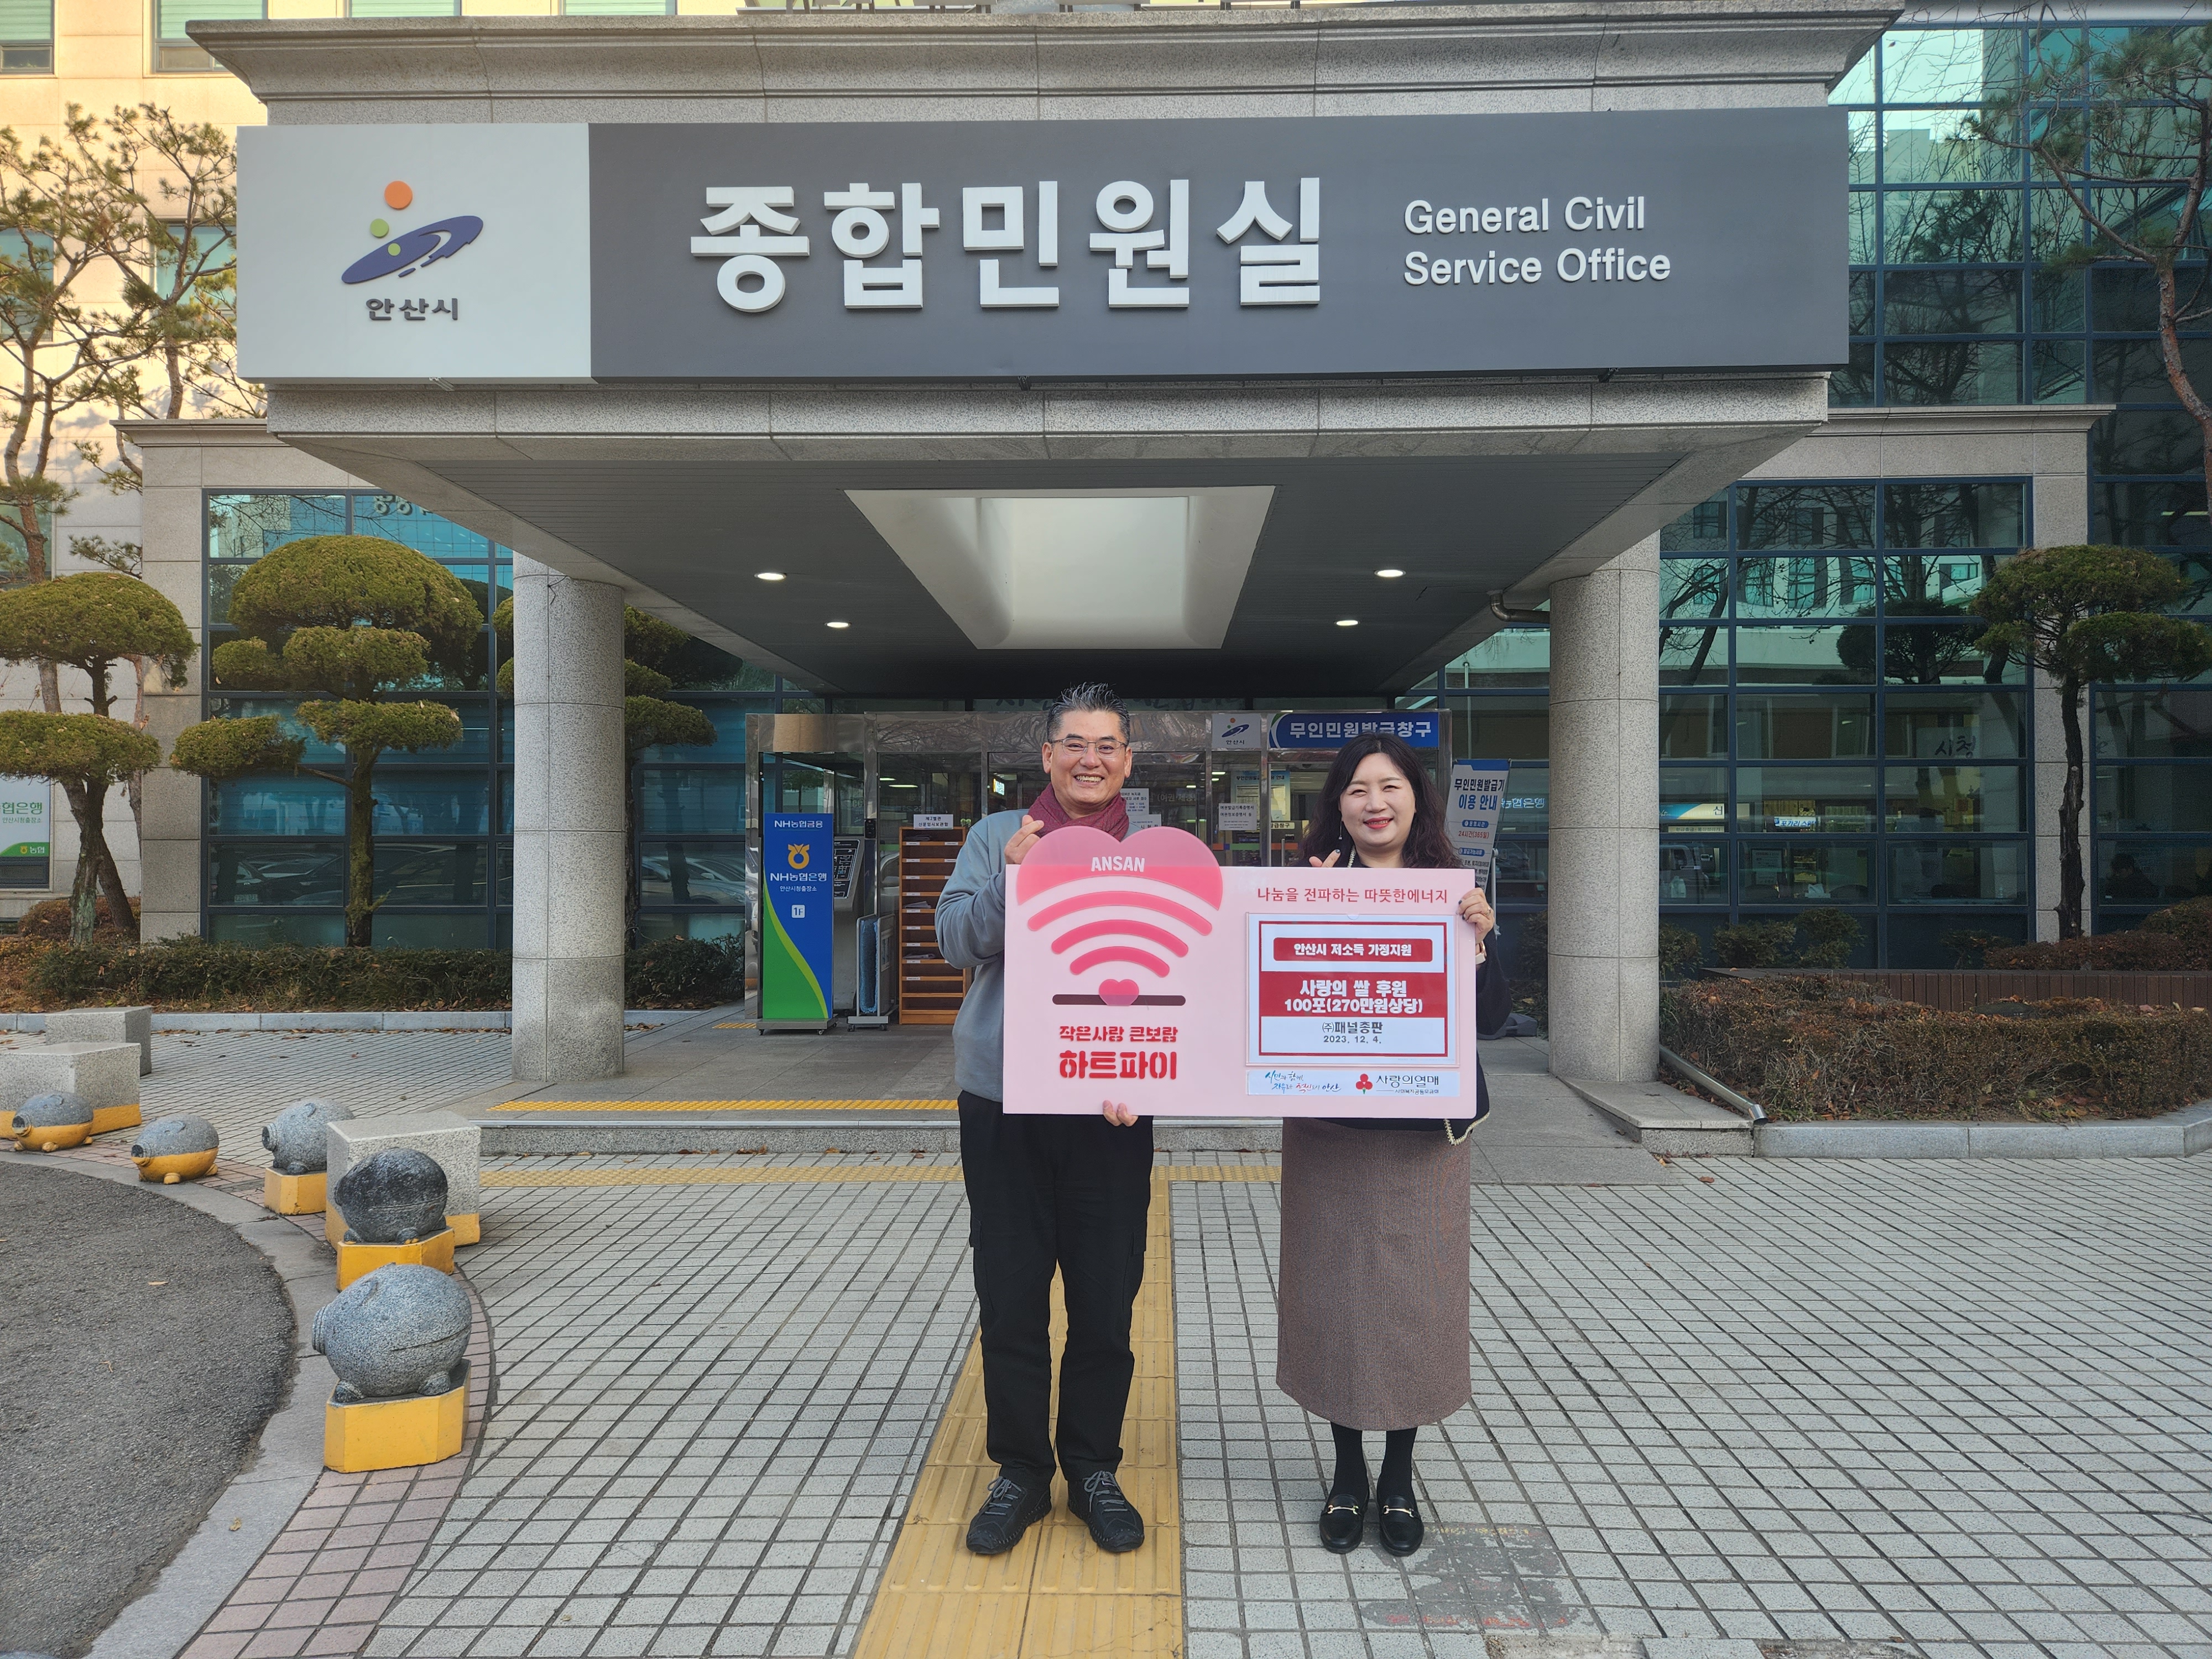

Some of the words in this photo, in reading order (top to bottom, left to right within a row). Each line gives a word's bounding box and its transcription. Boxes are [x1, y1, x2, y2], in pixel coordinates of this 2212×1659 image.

[1404, 198, 1549, 234] General
[1564, 196, 1645, 232] Civil
[690, 176, 1321, 314] 종합민원실
[1404, 250, 1542, 286] Service
[1557, 247, 1671, 283] Office
[366, 298, 459, 321] 안산시
[1934, 735, 1976, 759] 시청
[1454, 778, 1505, 792] 무인민원발급기
[0, 802, 43, 815] 협은행
[1458, 794, 1477, 810] 이용
[1479, 795, 1498, 811] 안내
[774, 820, 823, 828] NH농협금융
[1458, 831, 1489, 839] 24시간(365일)
[1091, 855, 1145, 872] ANSAN
[770, 872, 827, 882] NH농협은행
[1257, 887, 1298, 902] 나눔을
[1304, 888, 1360, 903] 전파하는
[1365, 888, 1448, 904] 따뜻한에너지
[794, 907, 804, 916] 1F
[1293, 943, 1327, 956] 안산시
[1331, 943, 1364, 957] 저소득
[1368, 943, 1412, 957] 가정지원
[1300, 979, 1347, 997] 사랑의
[1353, 979, 1371, 997] 쌀
[1376, 980, 1407, 997] 후원
[1284, 998, 1423, 1014] 100포(270만원상당)
[1059, 1025, 1124, 1043] 작은사랑
[1130, 1026, 1178, 1043] 큰보람
[1323, 1035, 1350, 1044] 2023.
[1354, 1035, 1369, 1044] 12.
[1373, 1035, 1382, 1044] 4.
[1059, 1050, 1177, 1080] 하트파이
[1322, 1083, 1342, 1092] 안산
[1376, 1075, 1439, 1088] 사랑의열매
